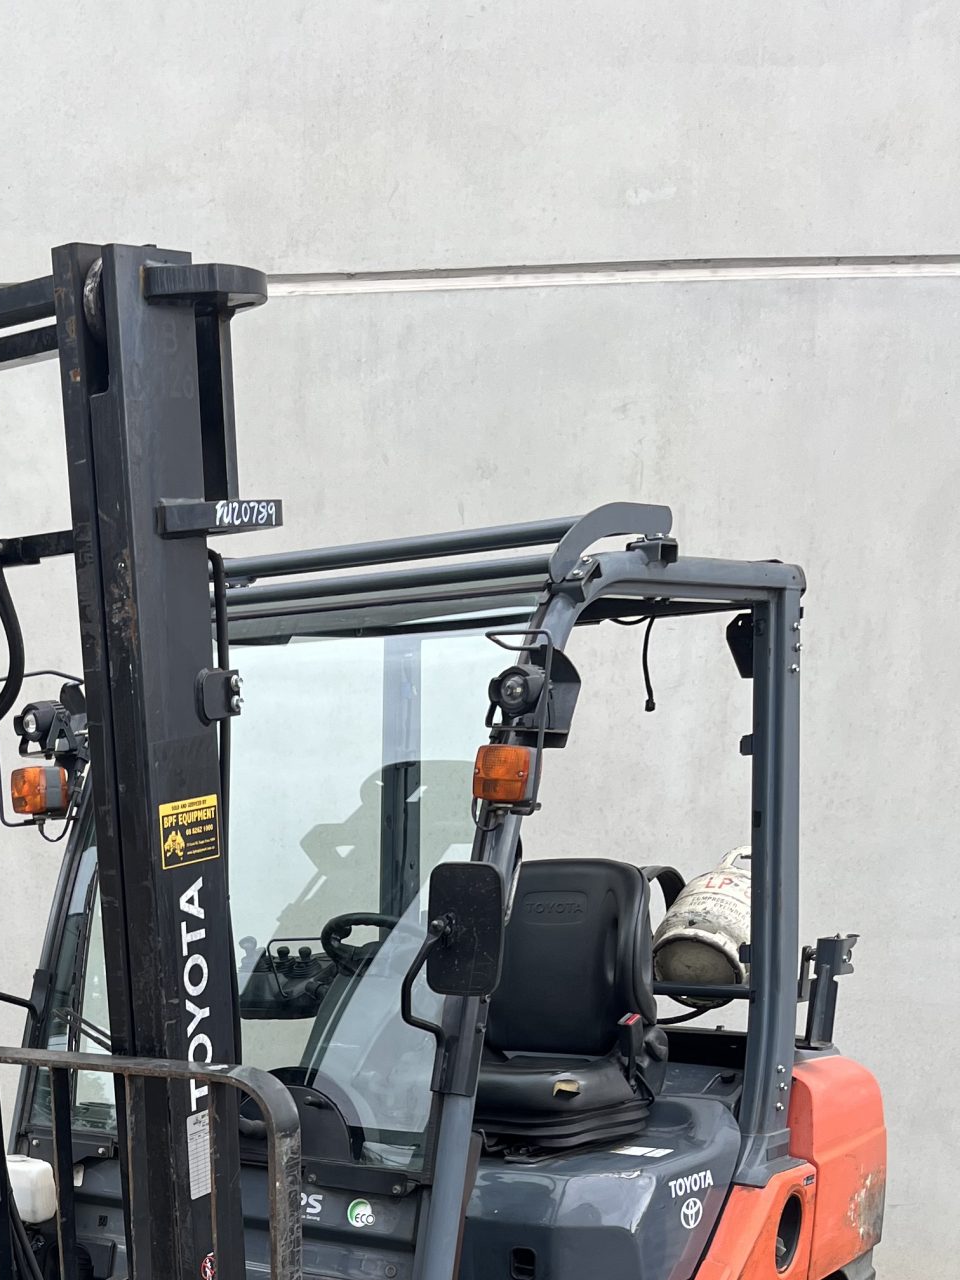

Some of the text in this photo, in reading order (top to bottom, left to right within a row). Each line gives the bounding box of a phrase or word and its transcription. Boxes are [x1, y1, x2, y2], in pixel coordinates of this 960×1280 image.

[164, 807, 215, 828] BPF EQUIPMENT
[526, 902, 584, 914] TOYOTA
[180, 876, 212, 1112] TOYOTA
[668, 1169, 714, 1199] TOYOTA
